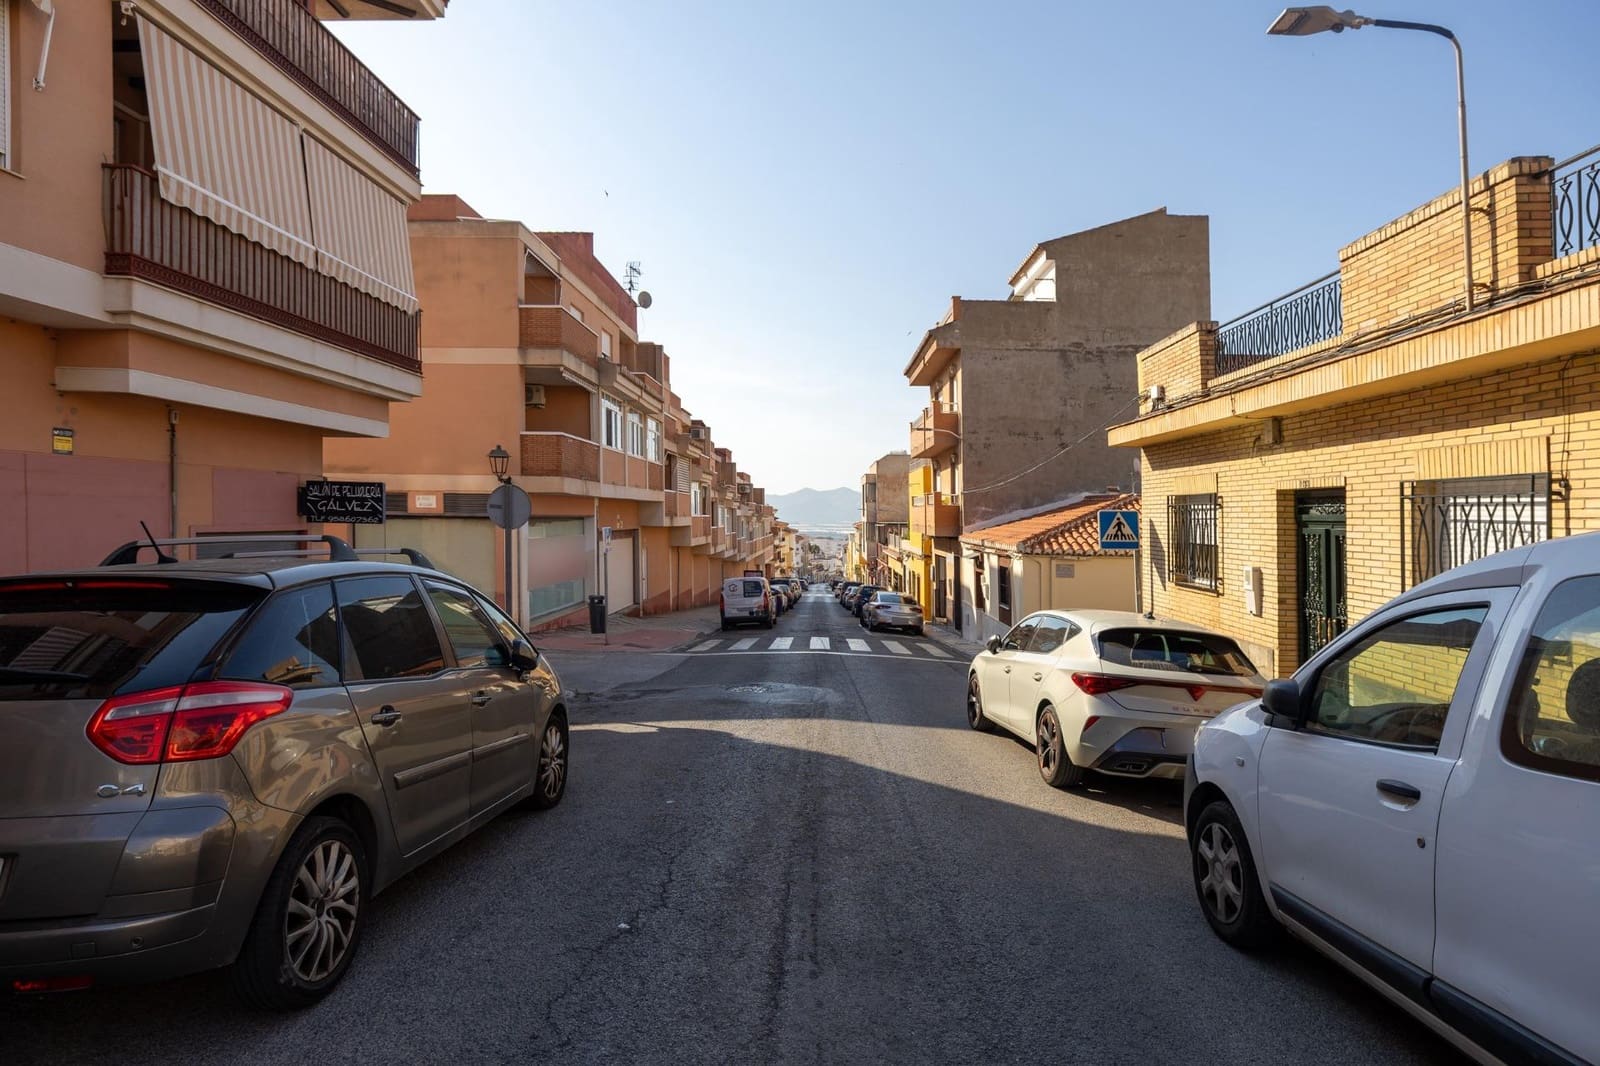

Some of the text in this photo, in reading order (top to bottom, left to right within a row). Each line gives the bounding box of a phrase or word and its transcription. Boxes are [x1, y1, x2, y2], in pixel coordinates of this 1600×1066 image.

[307, 483, 331, 496] SALÓN
[332, 485, 341, 497] DE
[317, 497, 373, 512] GÁLVEZ
[97, 783, 145, 797] C4
